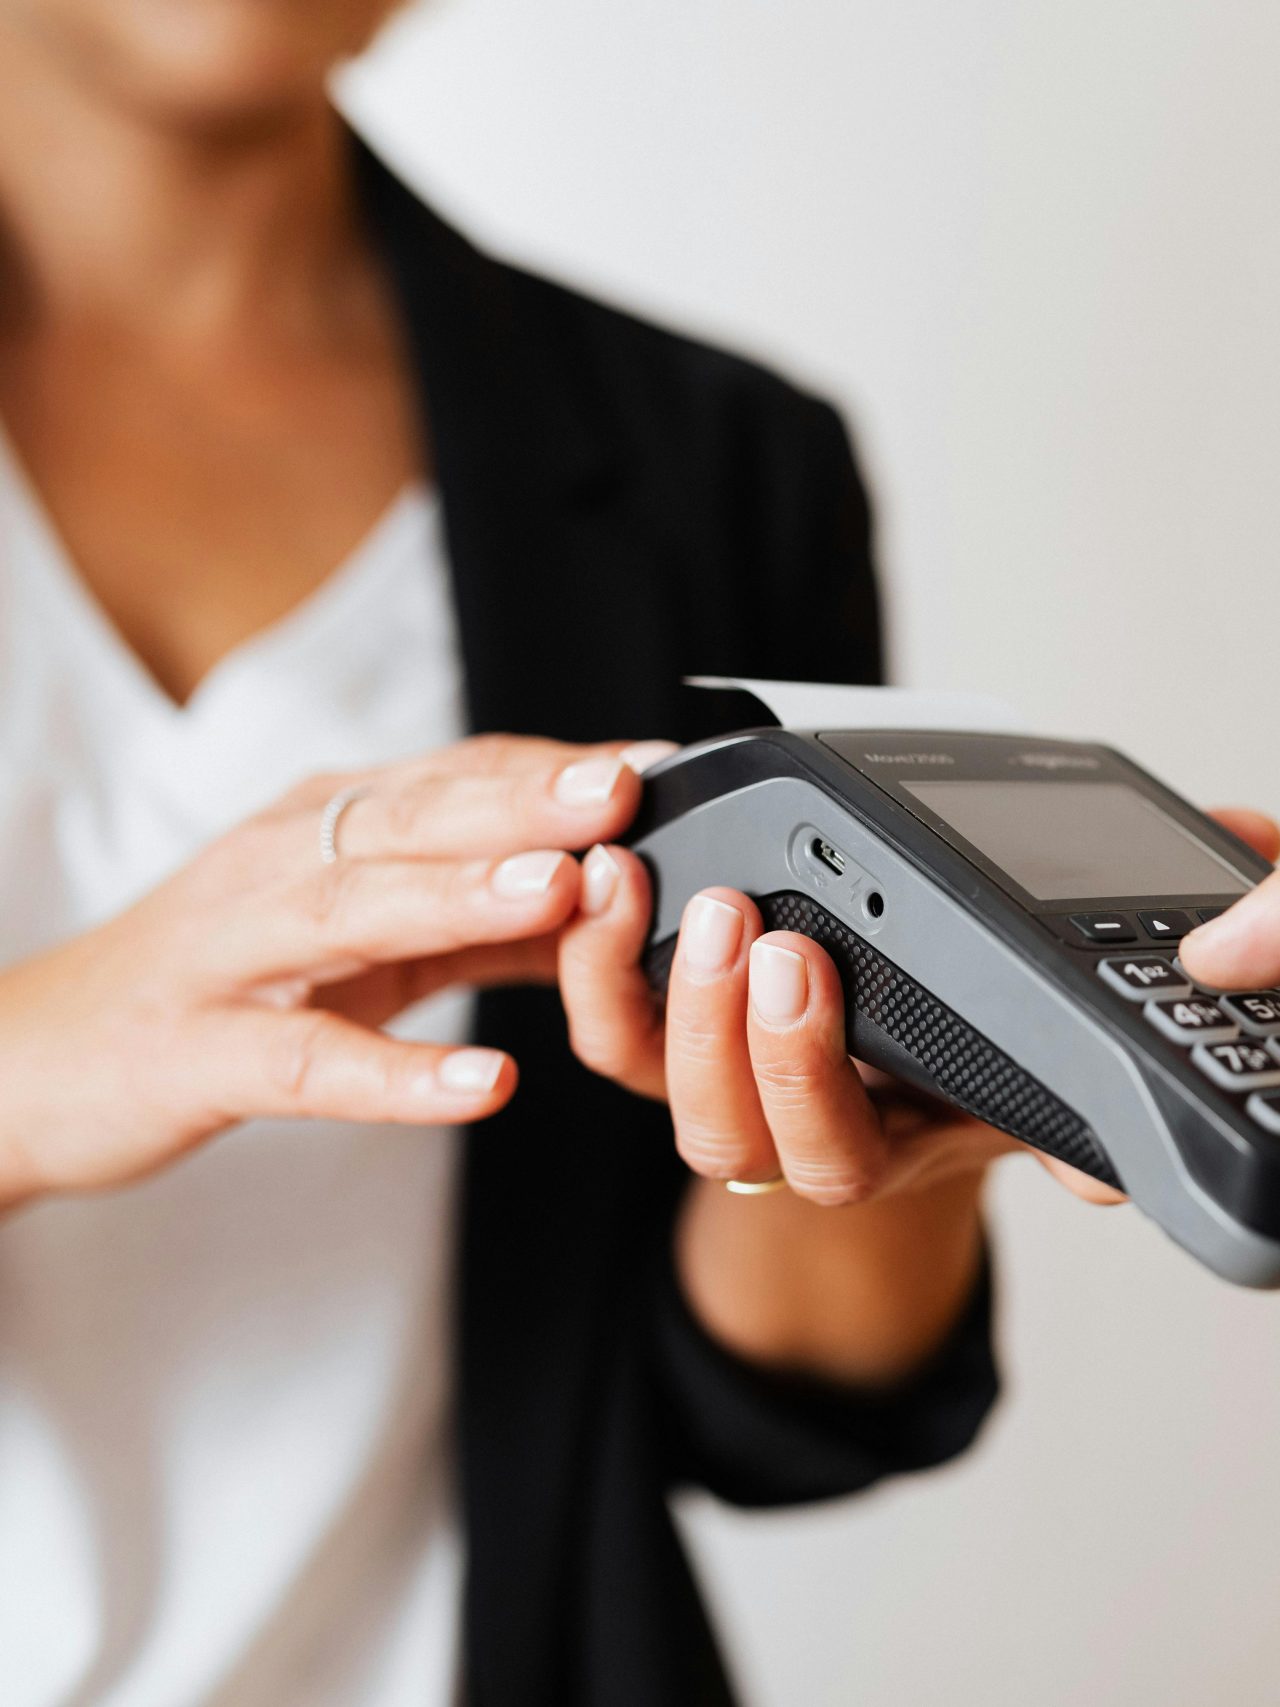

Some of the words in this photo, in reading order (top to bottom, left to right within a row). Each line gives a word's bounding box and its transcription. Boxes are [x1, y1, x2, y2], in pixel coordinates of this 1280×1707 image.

[1124, 963, 1151, 984] 1
[1173, 1003, 1202, 1026] 4
[1243, 998, 1276, 1019] 5
[1213, 1045, 1243, 1072] 7
